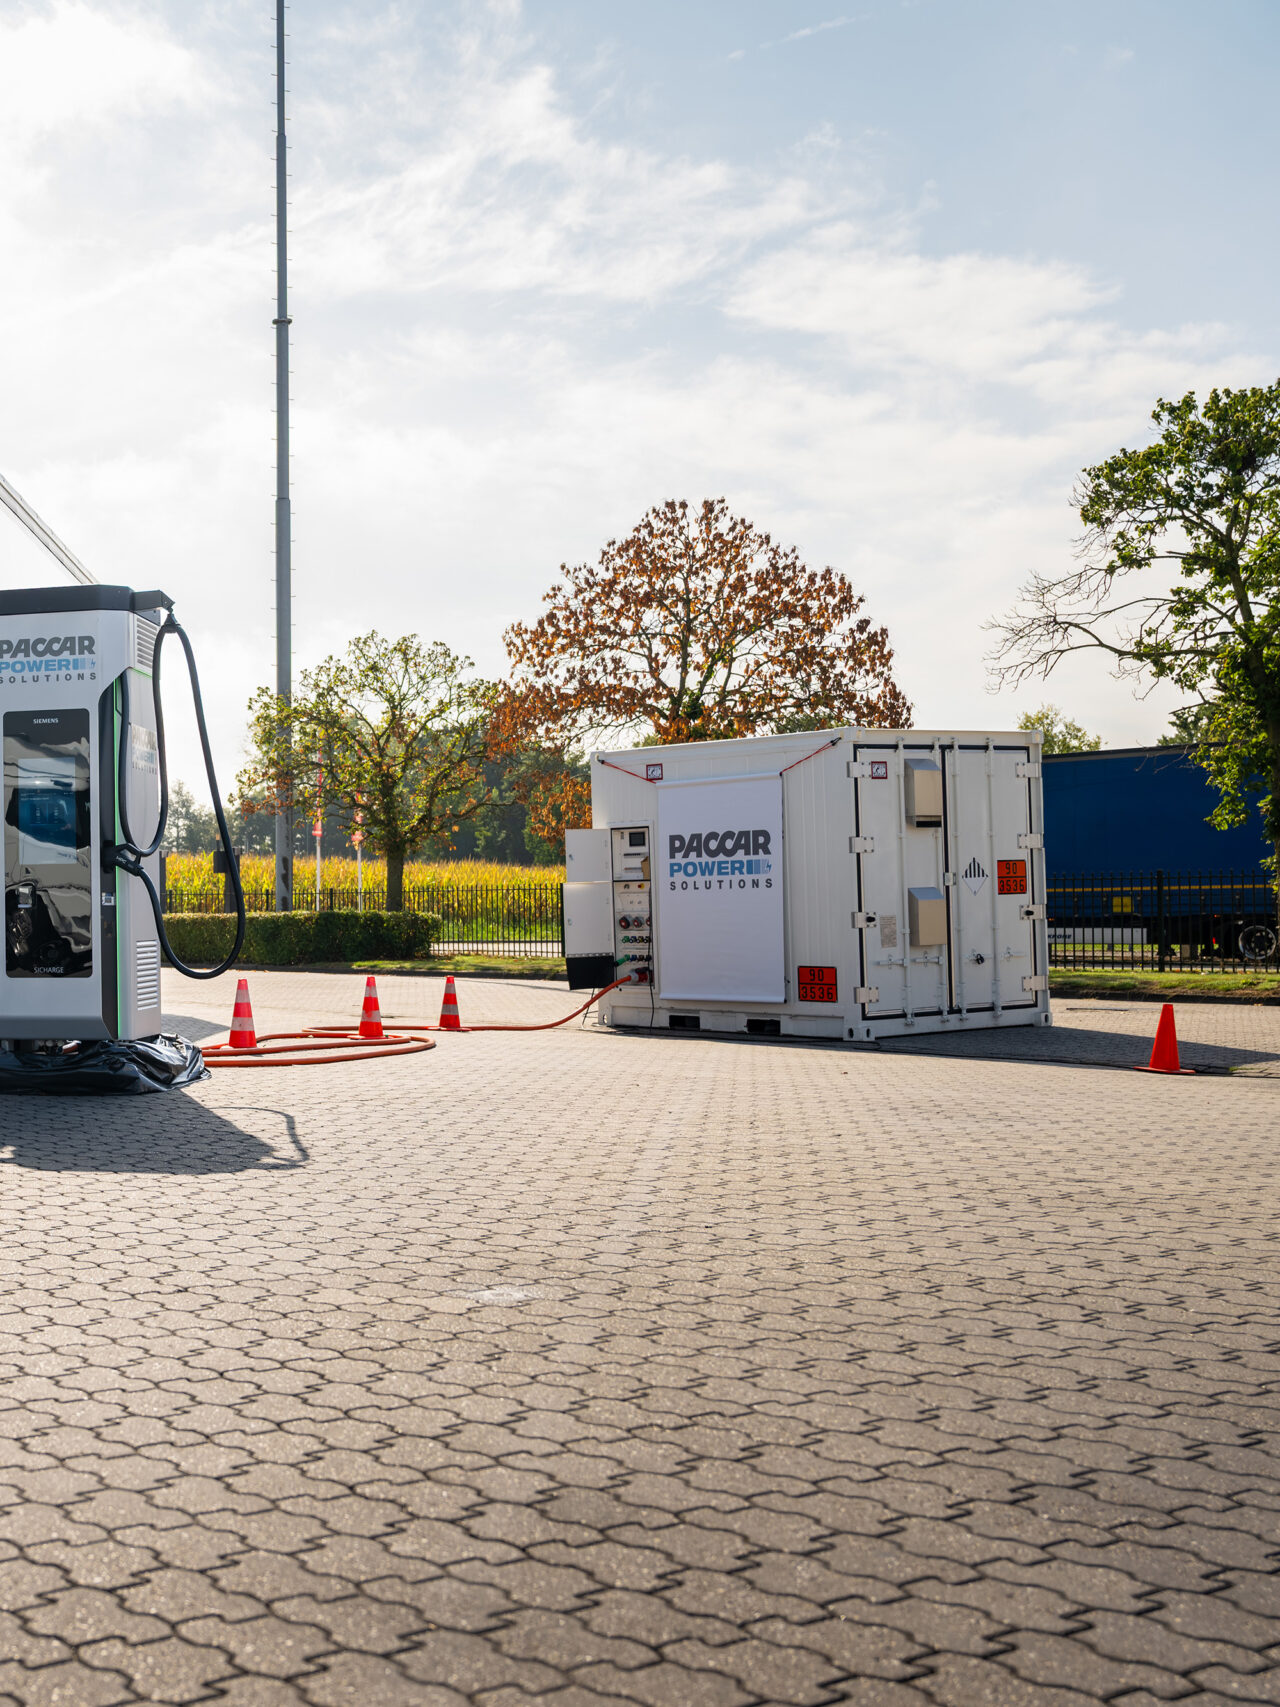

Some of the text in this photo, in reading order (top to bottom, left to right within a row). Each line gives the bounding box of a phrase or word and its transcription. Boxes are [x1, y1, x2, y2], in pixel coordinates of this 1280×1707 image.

[669, 829, 772, 859] PACCAR
[669, 860, 745, 877] POWER
[1005, 862, 1017, 875] 90
[670, 878, 773, 891] SOLUTIONS
[999, 879, 1025, 892] 3536
[33, 966, 64, 974] SICHARGE
[809, 968, 824, 982] 90
[801, 986, 833, 1000] 3536
